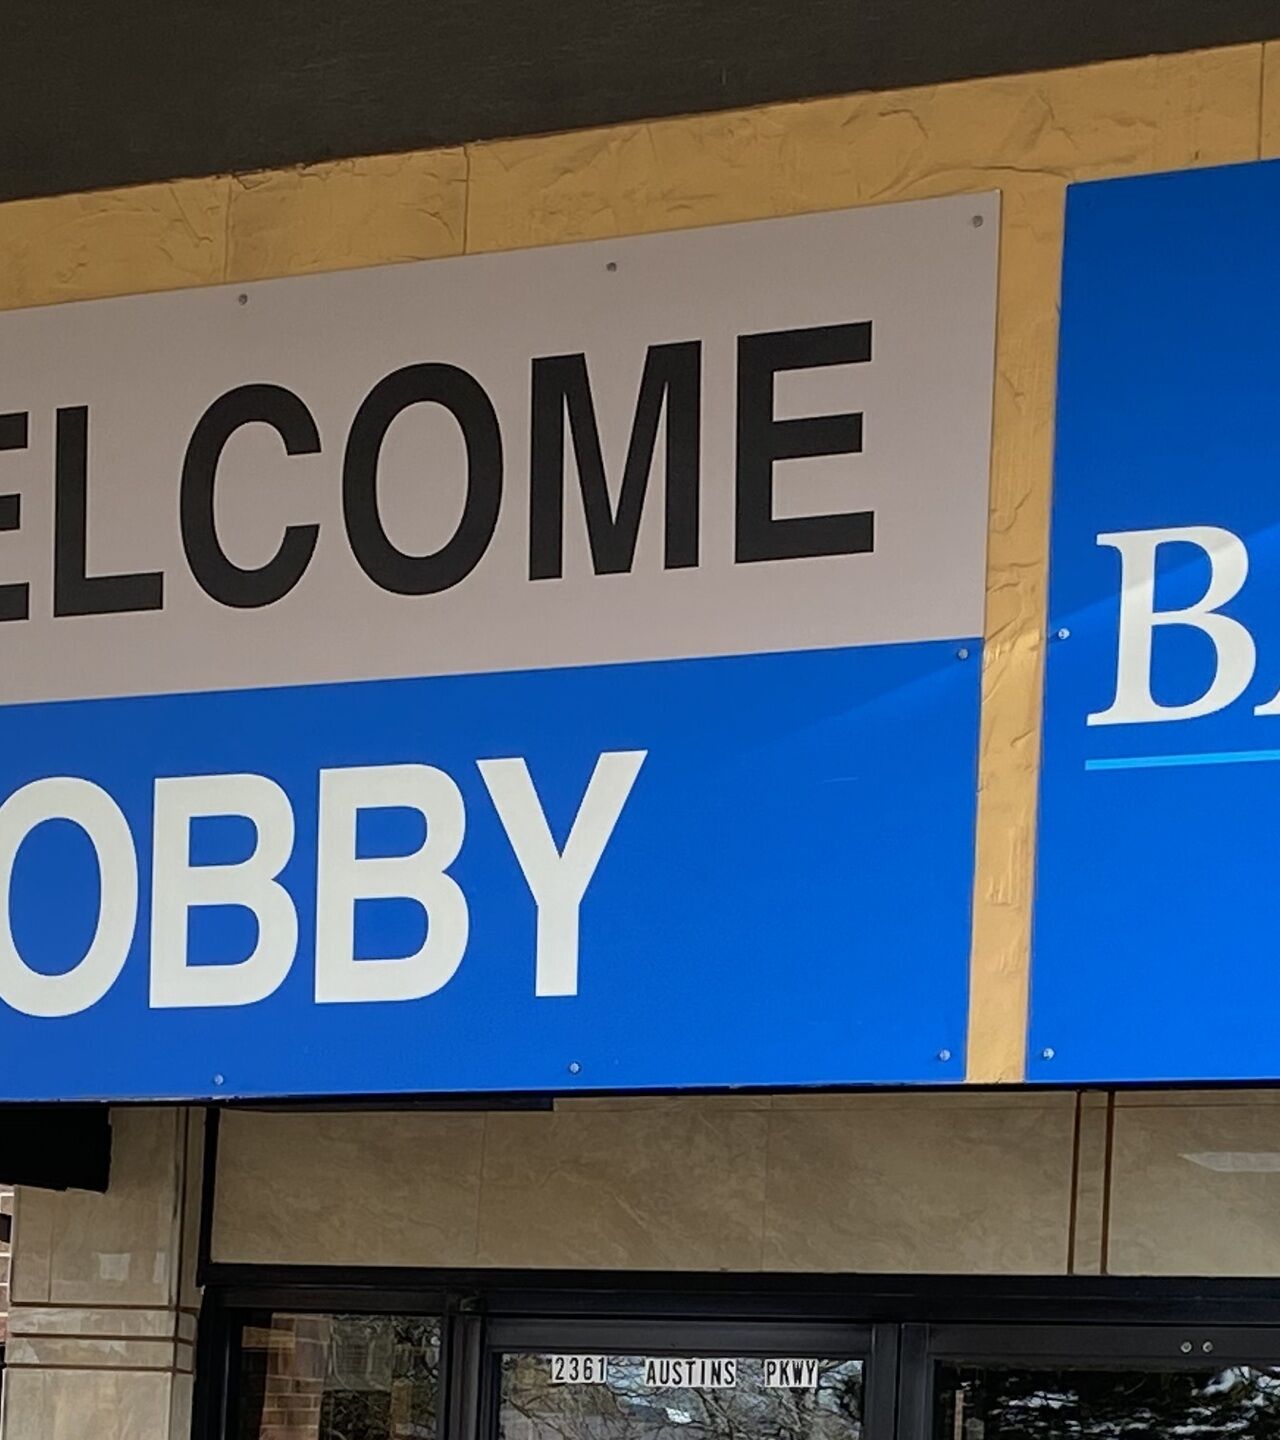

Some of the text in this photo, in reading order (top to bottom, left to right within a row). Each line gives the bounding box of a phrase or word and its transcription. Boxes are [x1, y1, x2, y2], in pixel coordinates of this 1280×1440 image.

[553, 1357, 818, 1387] 2361 AUSTINS PKWY
